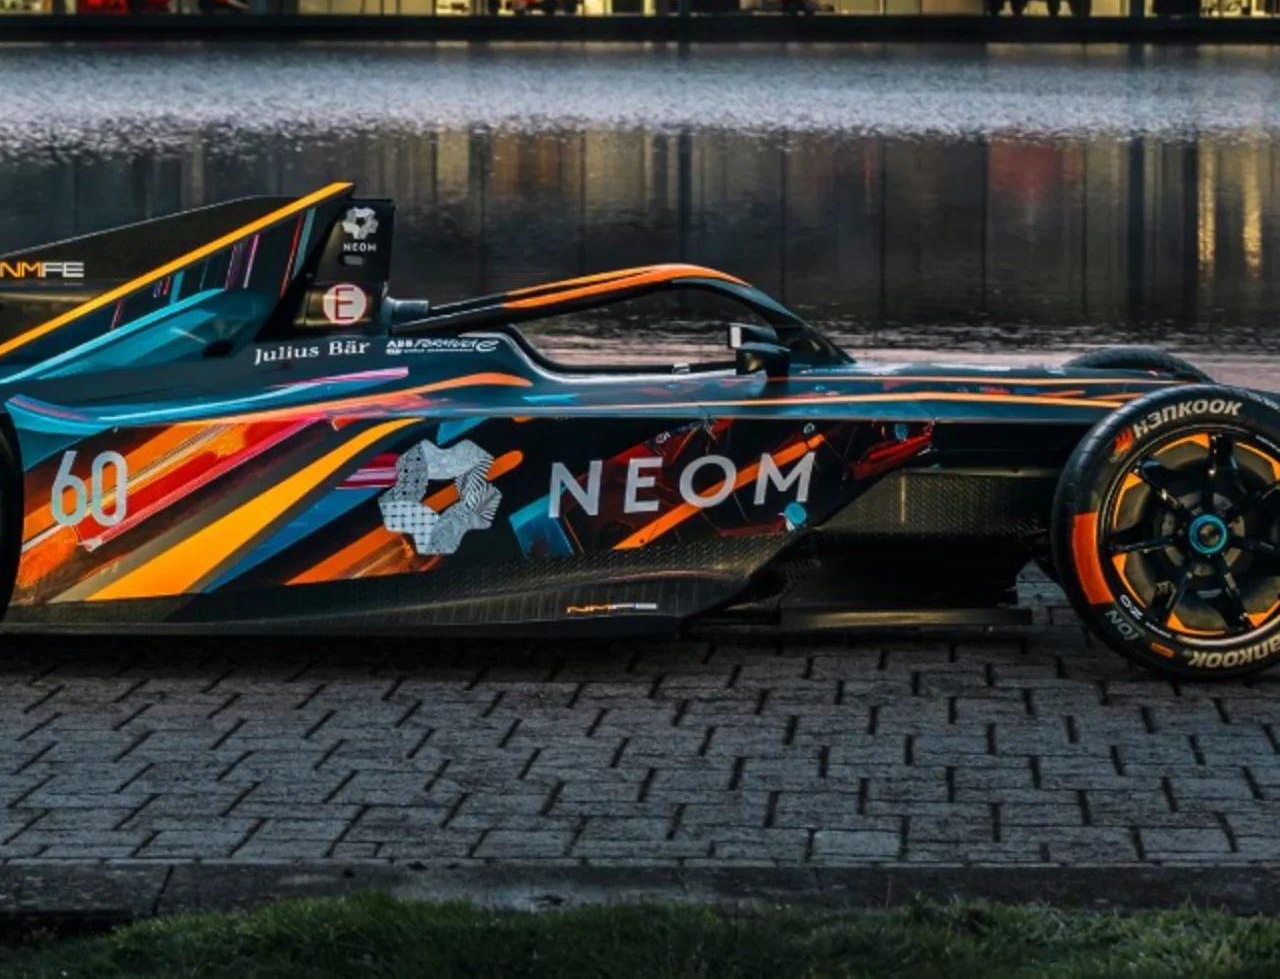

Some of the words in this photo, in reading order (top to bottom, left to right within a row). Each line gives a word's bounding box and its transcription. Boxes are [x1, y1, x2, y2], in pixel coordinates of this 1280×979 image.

[343, 242, 377, 252] NEOM
[0, 261, 85, 278] NMFE
[254, 345, 319, 366] Julius
[328, 340, 371, 356] Bär
[51, 450, 128, 527] 60
[548, 452, 817, 518] NEOM
